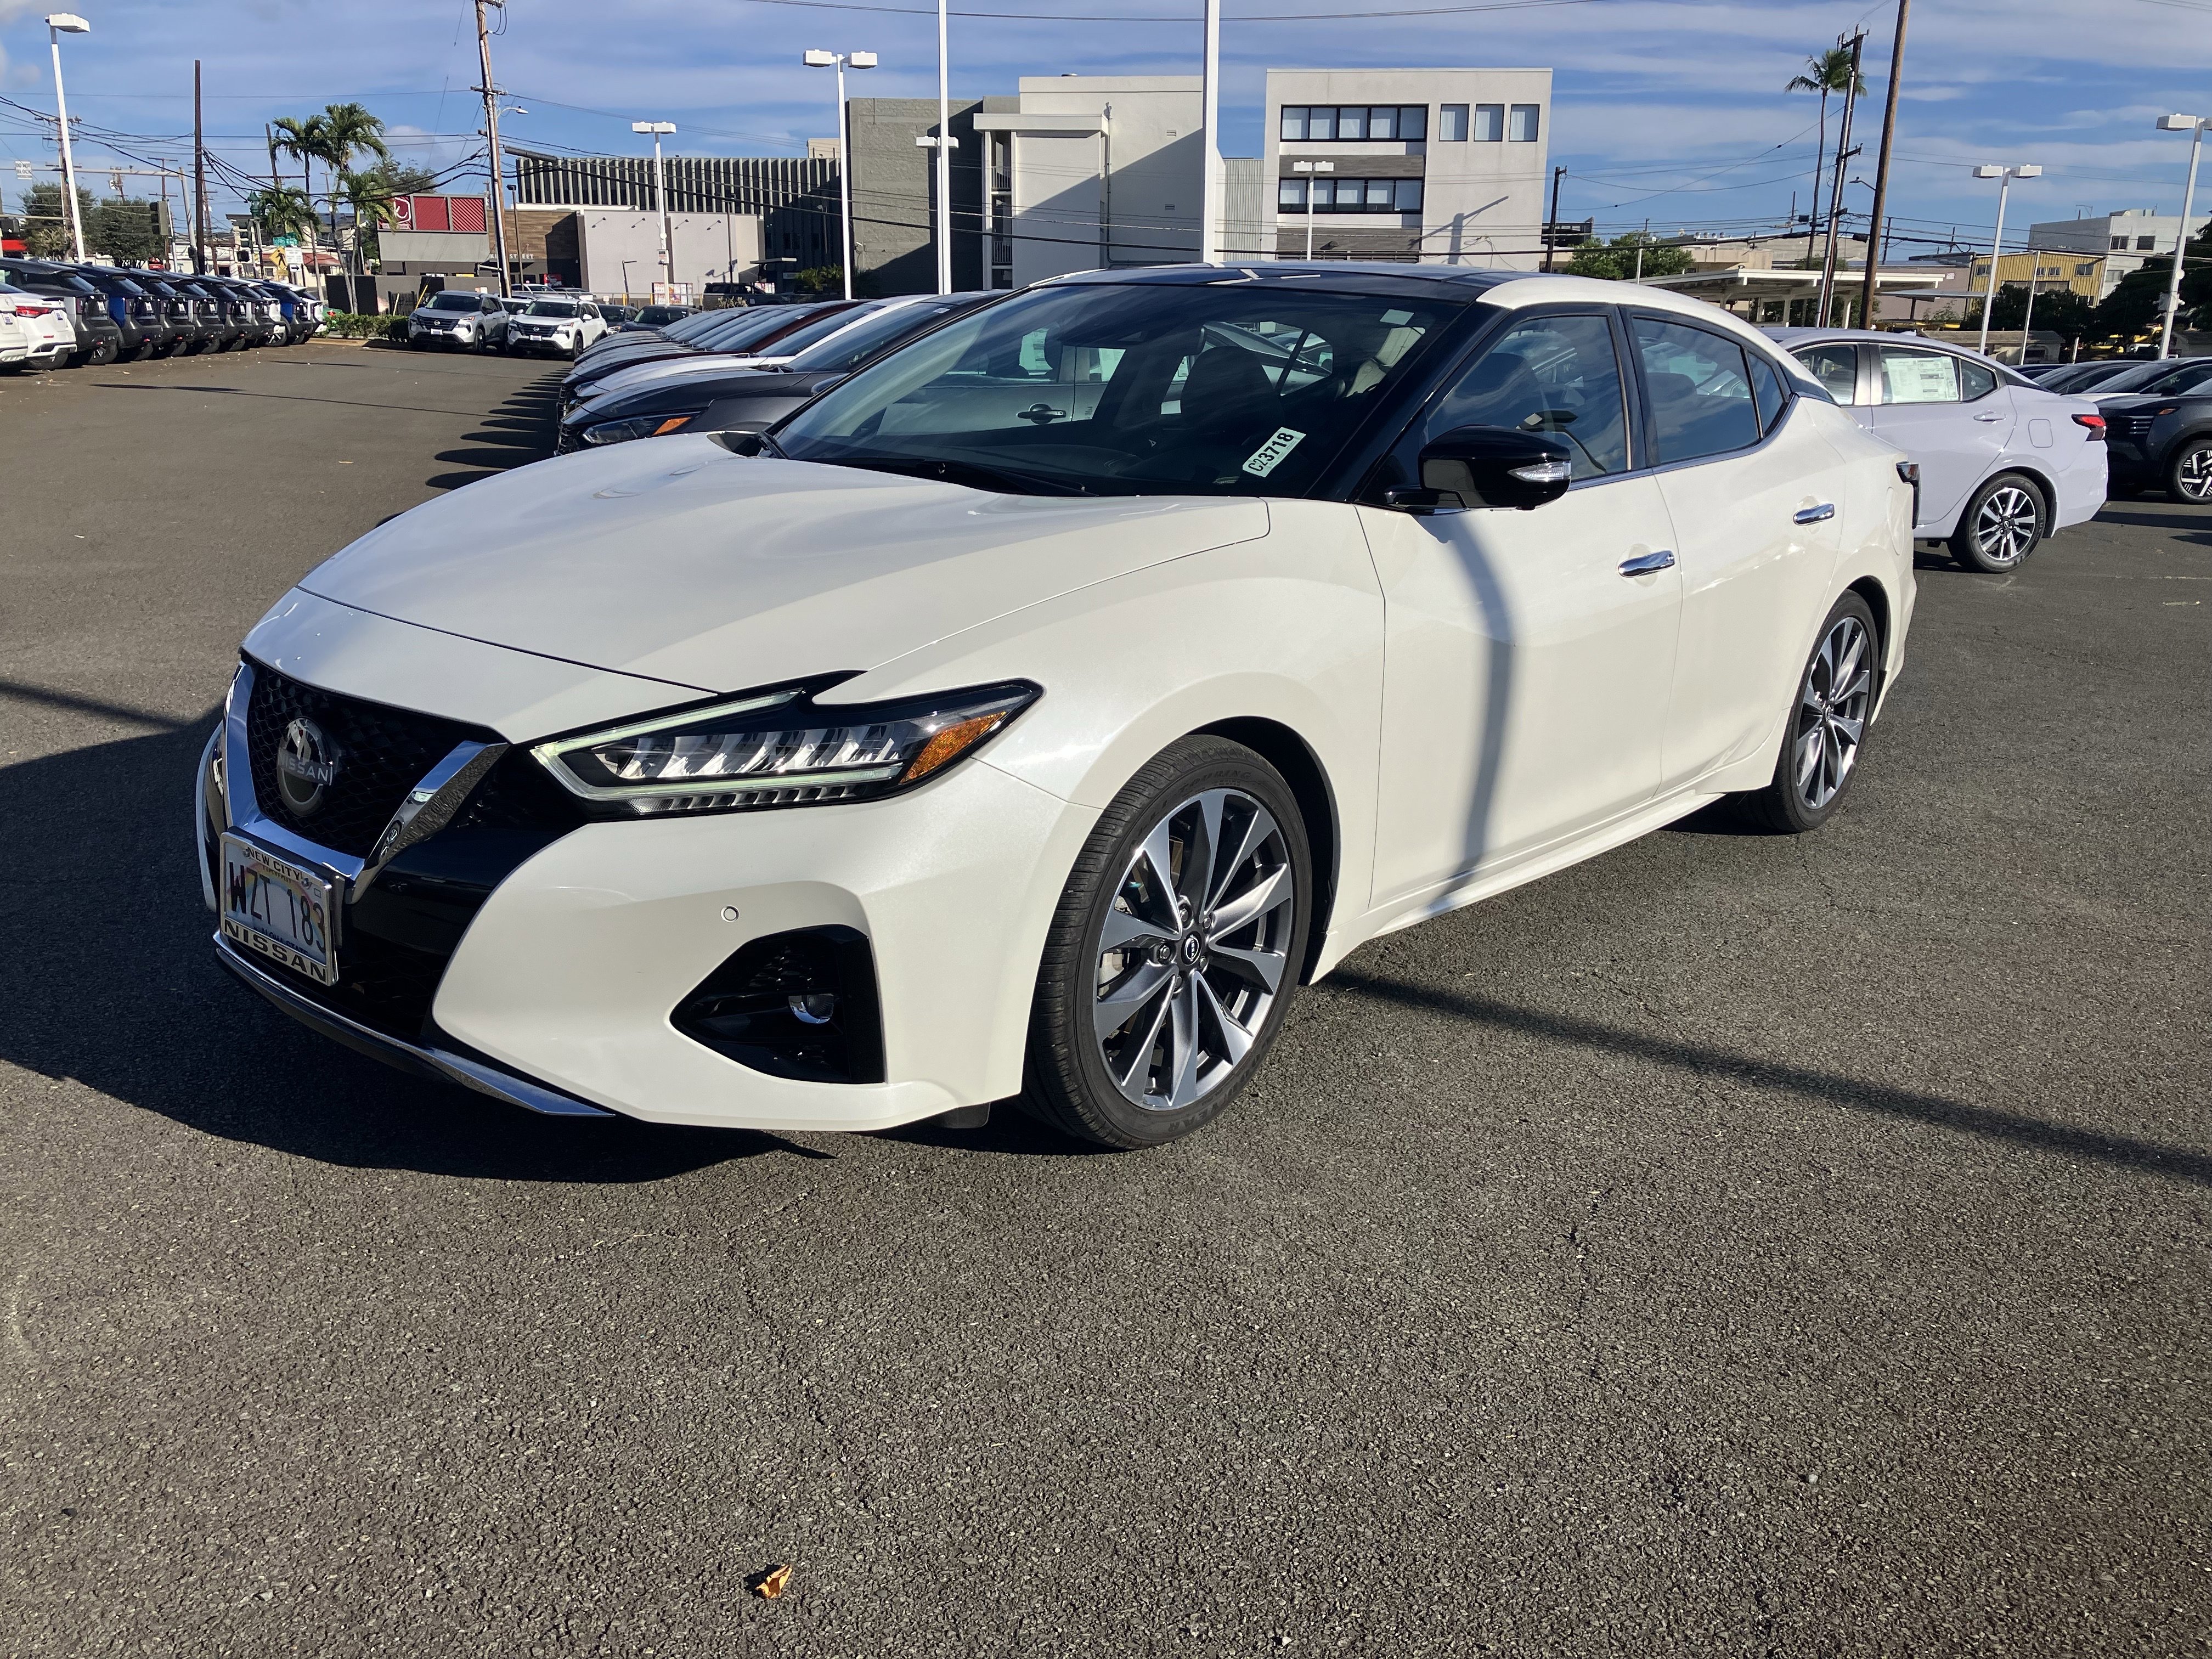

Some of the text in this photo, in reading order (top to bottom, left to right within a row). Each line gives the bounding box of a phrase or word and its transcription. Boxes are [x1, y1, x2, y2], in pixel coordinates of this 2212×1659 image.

[1248, 432, 1294, 471] C23718
[247, 847, 269, 866] NEW
[273, 860, 301, 881] CITY
[229, 861, 326, 953] WZT 183
[224, 919, 326, 983] NISSAN
